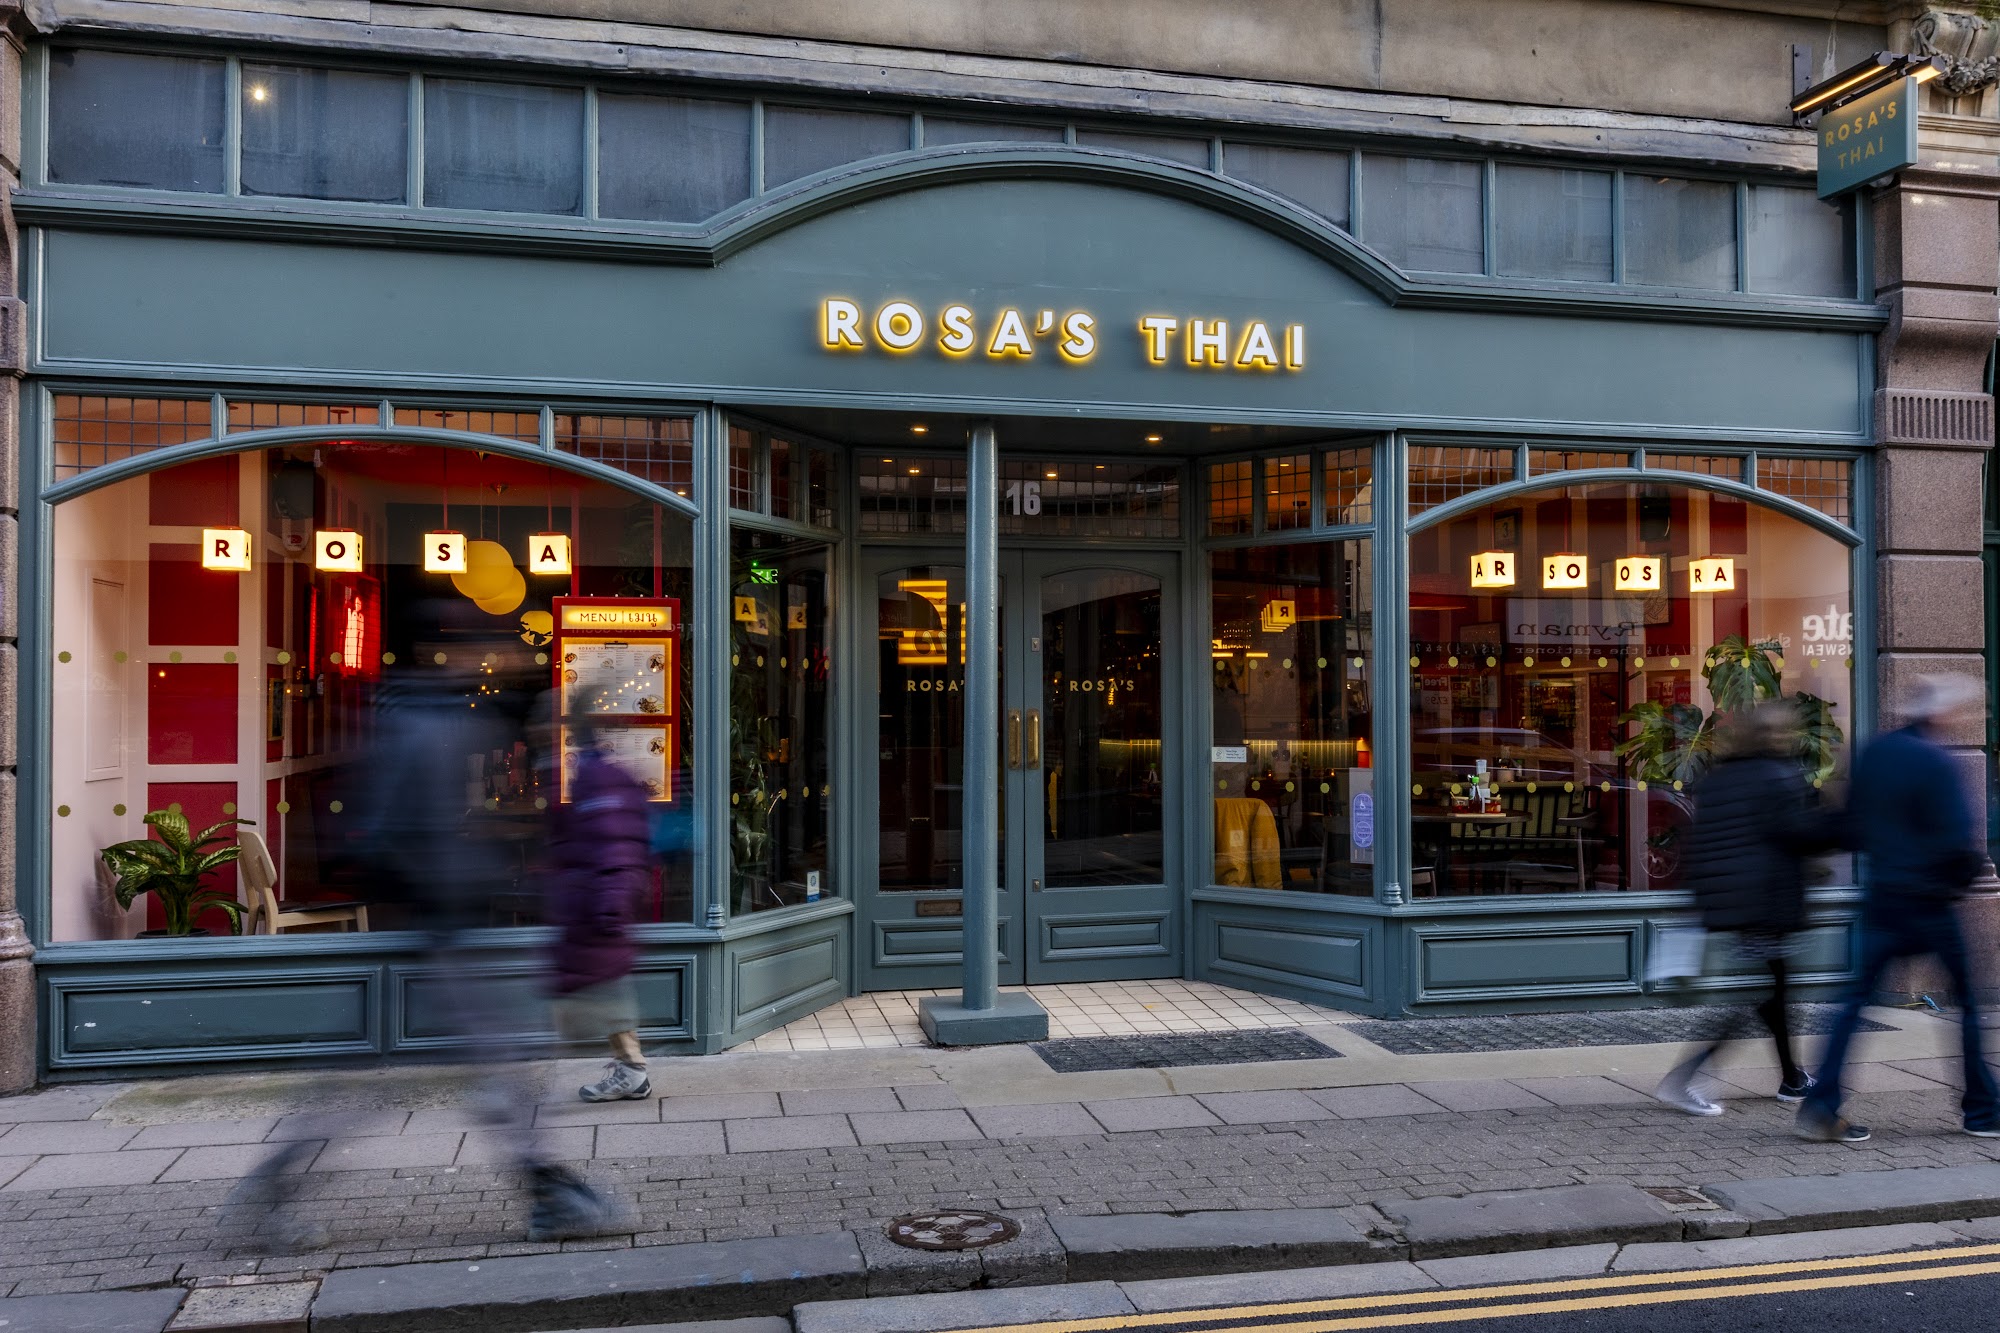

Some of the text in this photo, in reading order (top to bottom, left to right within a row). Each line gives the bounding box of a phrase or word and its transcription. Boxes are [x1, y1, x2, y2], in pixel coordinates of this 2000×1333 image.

[1825, 101, 1897, 148] ROSA'S
[1838, 136, 1884, 169] THAI
[825, 299, 1305, 368] ROSA'S THAI
[1006, 481, 1041, 516] 16
[215, 539, 231, 558] R
[325, 540, 346, 560] O
[437, 543, 451, 562] S
[540, 545, 557, 562] A
[580, 613, 617, 622] MENU
[628, 612, 658, 628] เมนู
[907, 679, 965, 692] ROSA'
[1069, 679, 1135, 692] ROSA'S
